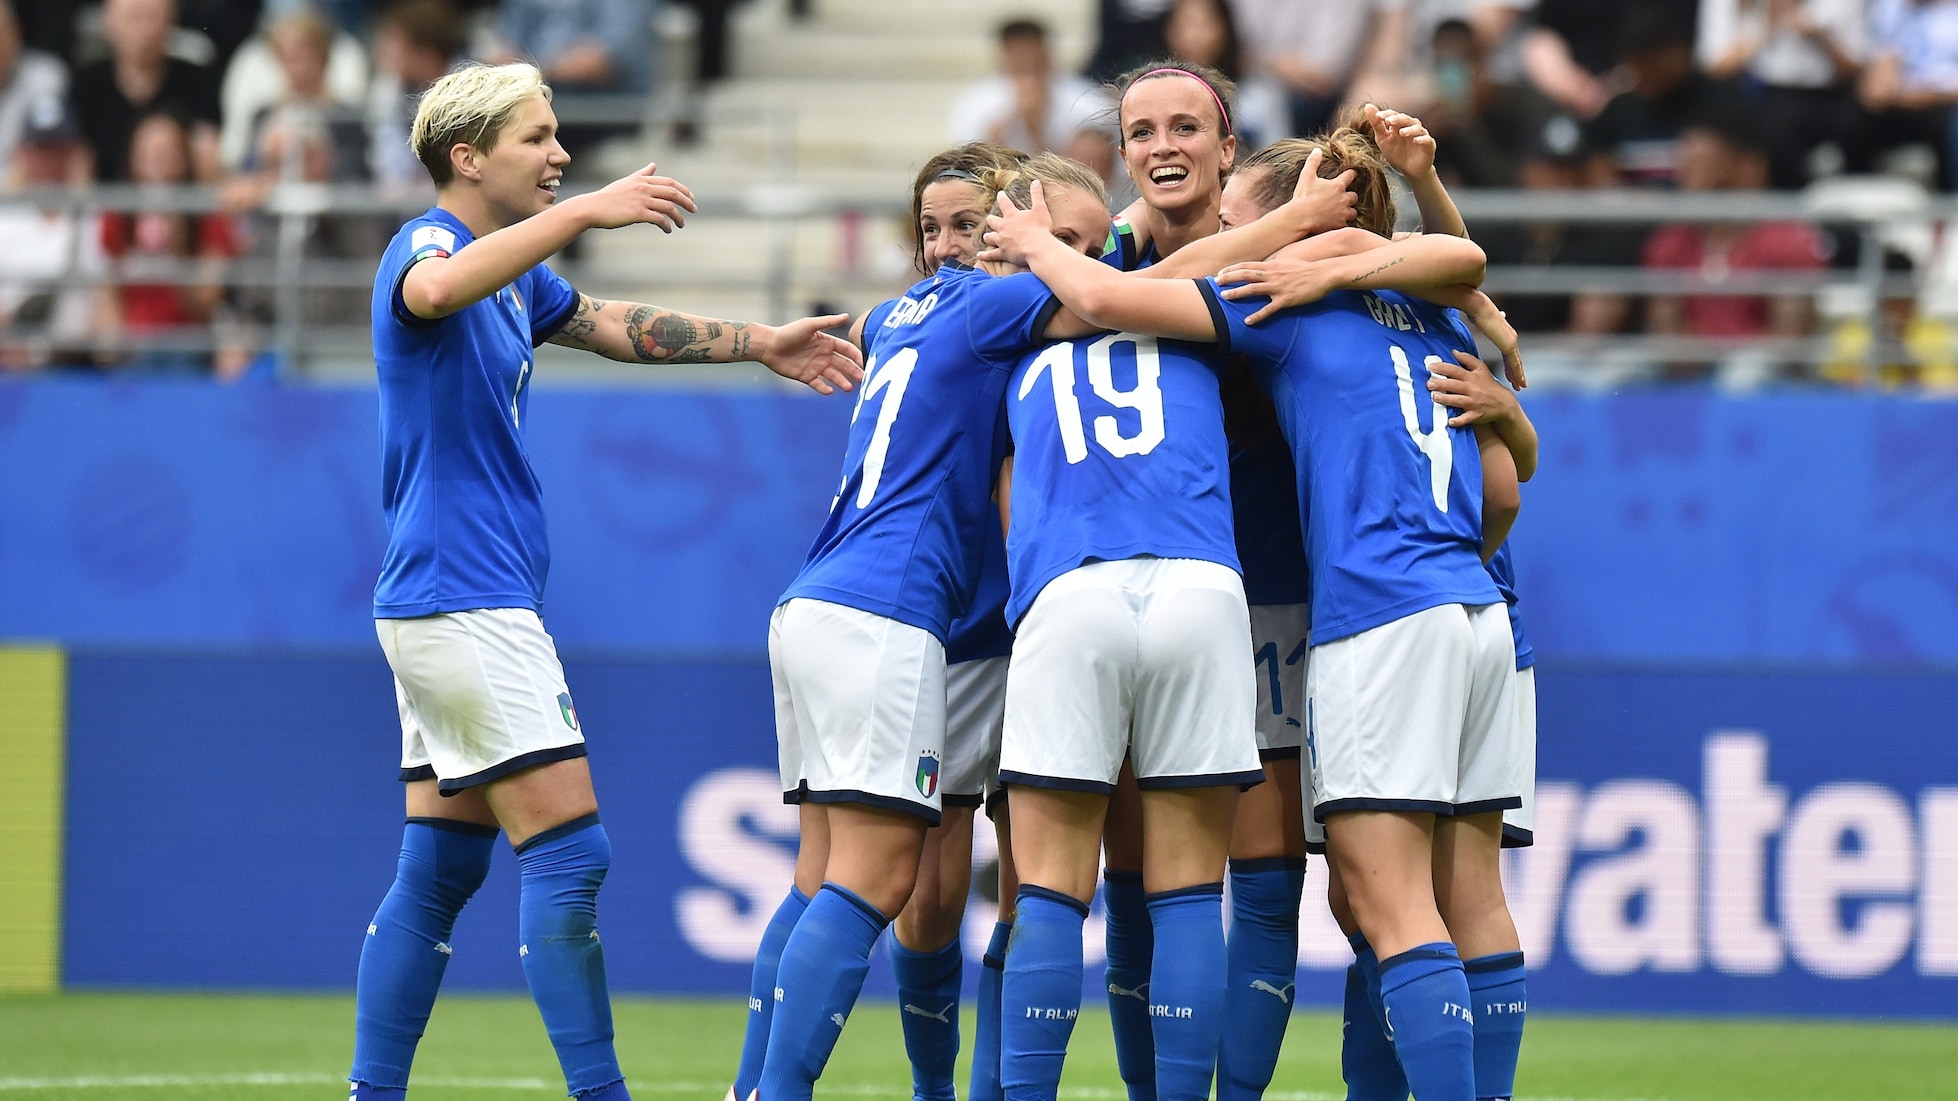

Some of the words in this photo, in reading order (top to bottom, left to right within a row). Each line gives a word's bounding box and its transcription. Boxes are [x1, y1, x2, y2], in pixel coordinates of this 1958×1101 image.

[1018, 331, 1166, 465] 19
[1389, 345, 1453, 514] 4
[1026, 1006, 1078, 1020] ITALIA
